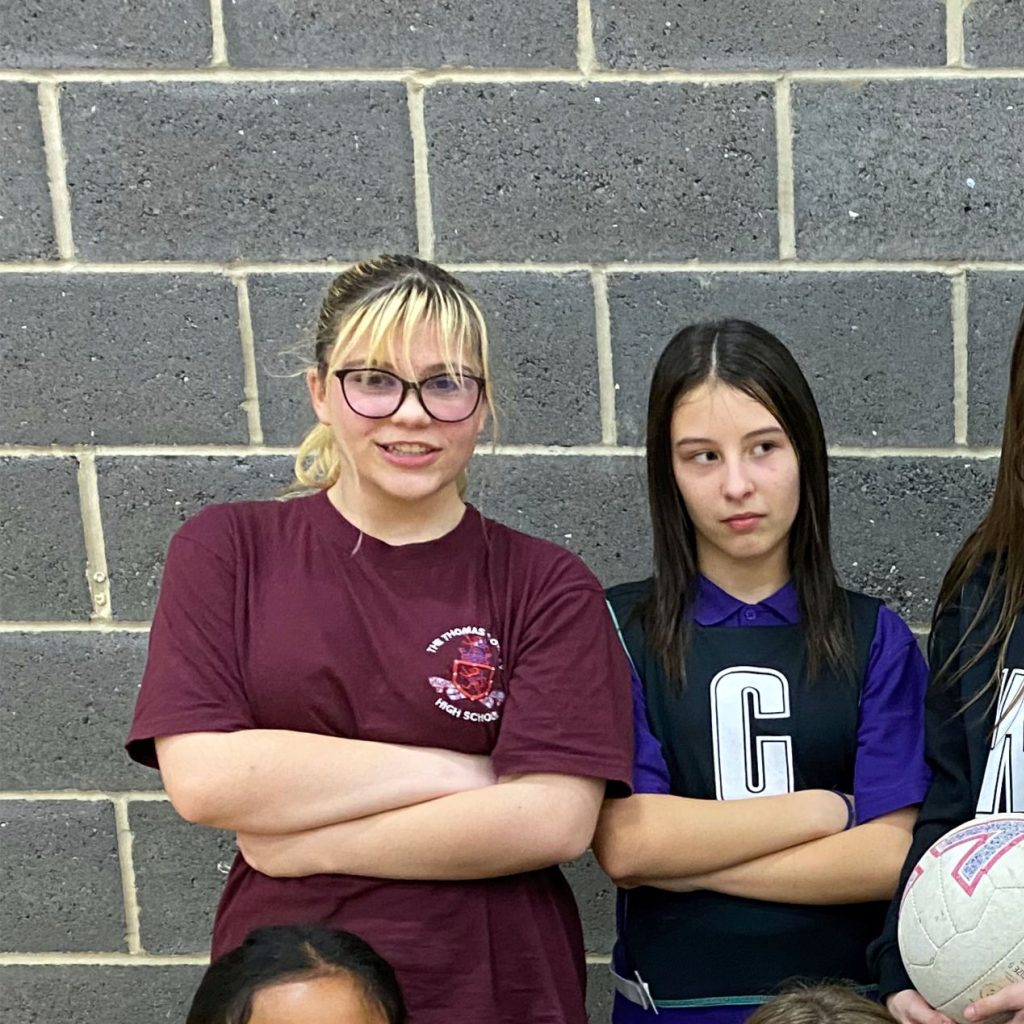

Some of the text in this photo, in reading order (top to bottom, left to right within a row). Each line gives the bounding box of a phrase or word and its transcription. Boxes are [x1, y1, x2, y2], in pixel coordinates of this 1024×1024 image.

[440, 626, 486, 641] THOMAS
[434, 698, 461, 718] HIGH
[710, 665, 795, 801] C
